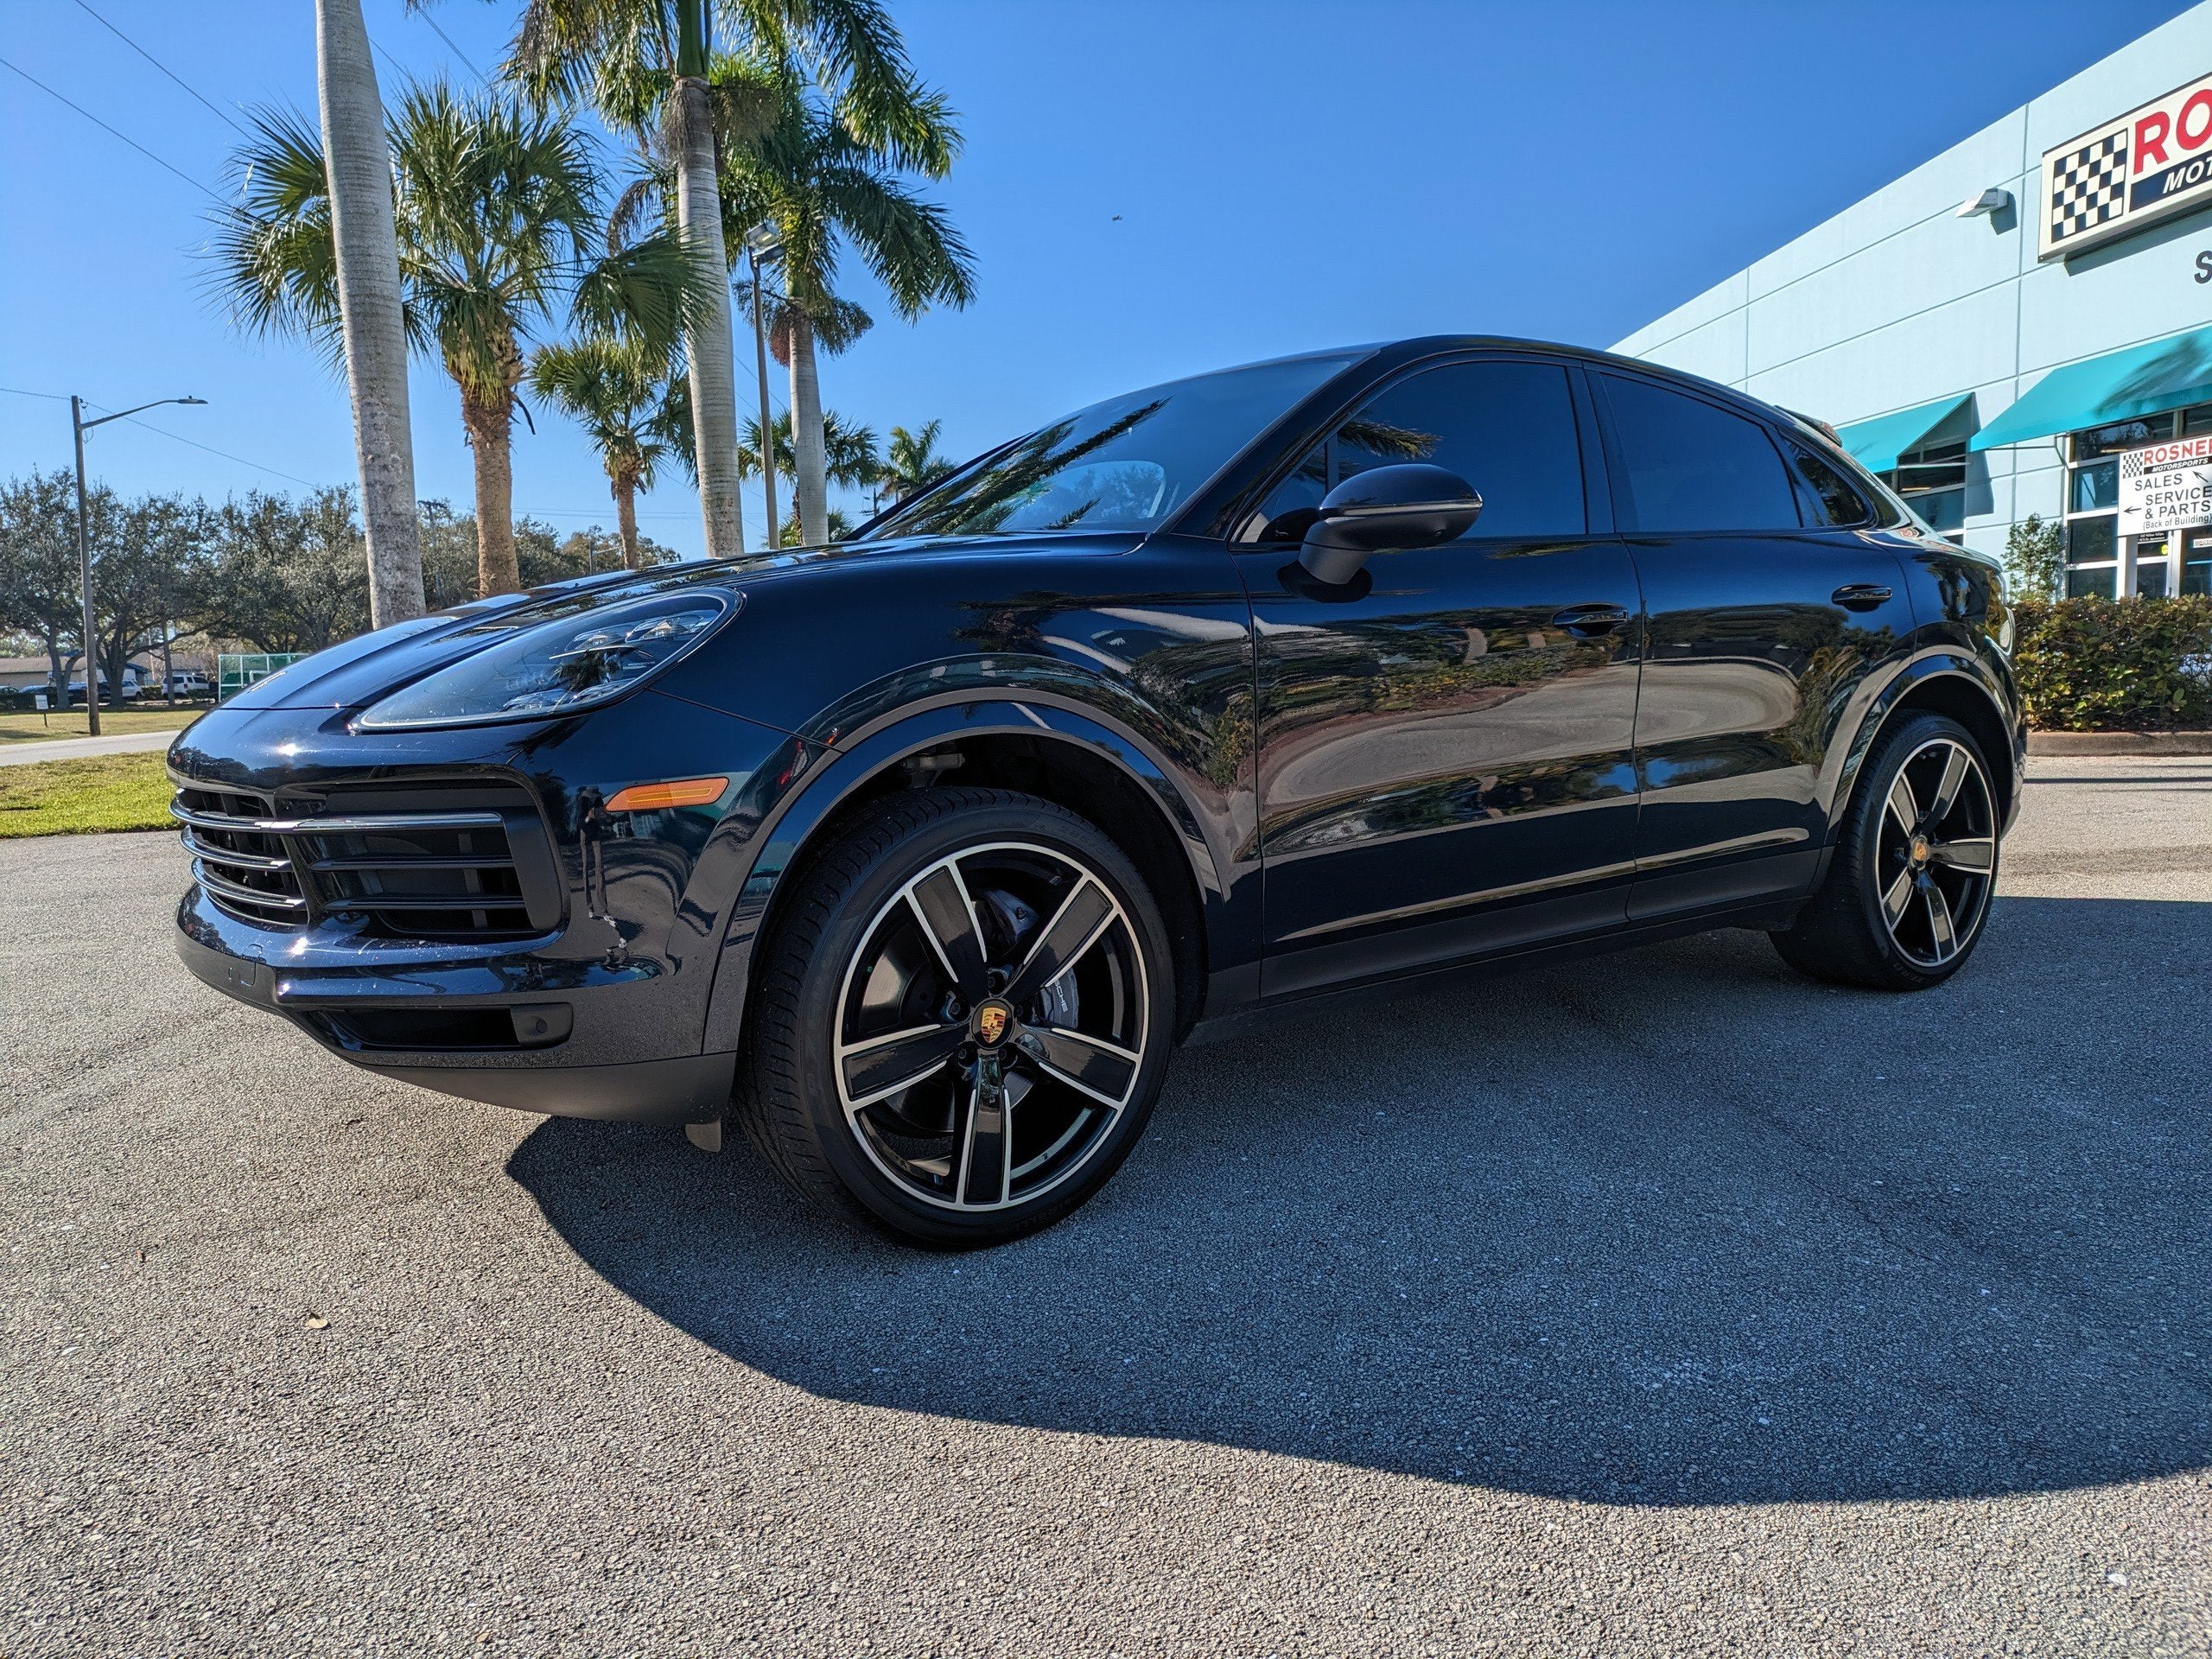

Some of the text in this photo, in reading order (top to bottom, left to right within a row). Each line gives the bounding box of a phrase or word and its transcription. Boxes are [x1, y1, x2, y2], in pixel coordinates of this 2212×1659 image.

[2133, 89, 2212, 175] RO
[2195, 251, 2212, 283] S
[2144, 438, 2212, 465] ROSNE
[2152, 457, 2209, 473] MOTORSPORTS
[2135, 474, 2183, 492] SALES
[2145, 486, 2212, 505] SERVICE
[2145, 500, 2210, 519] & PARTS
[2165, 518, 2172, 527] of
